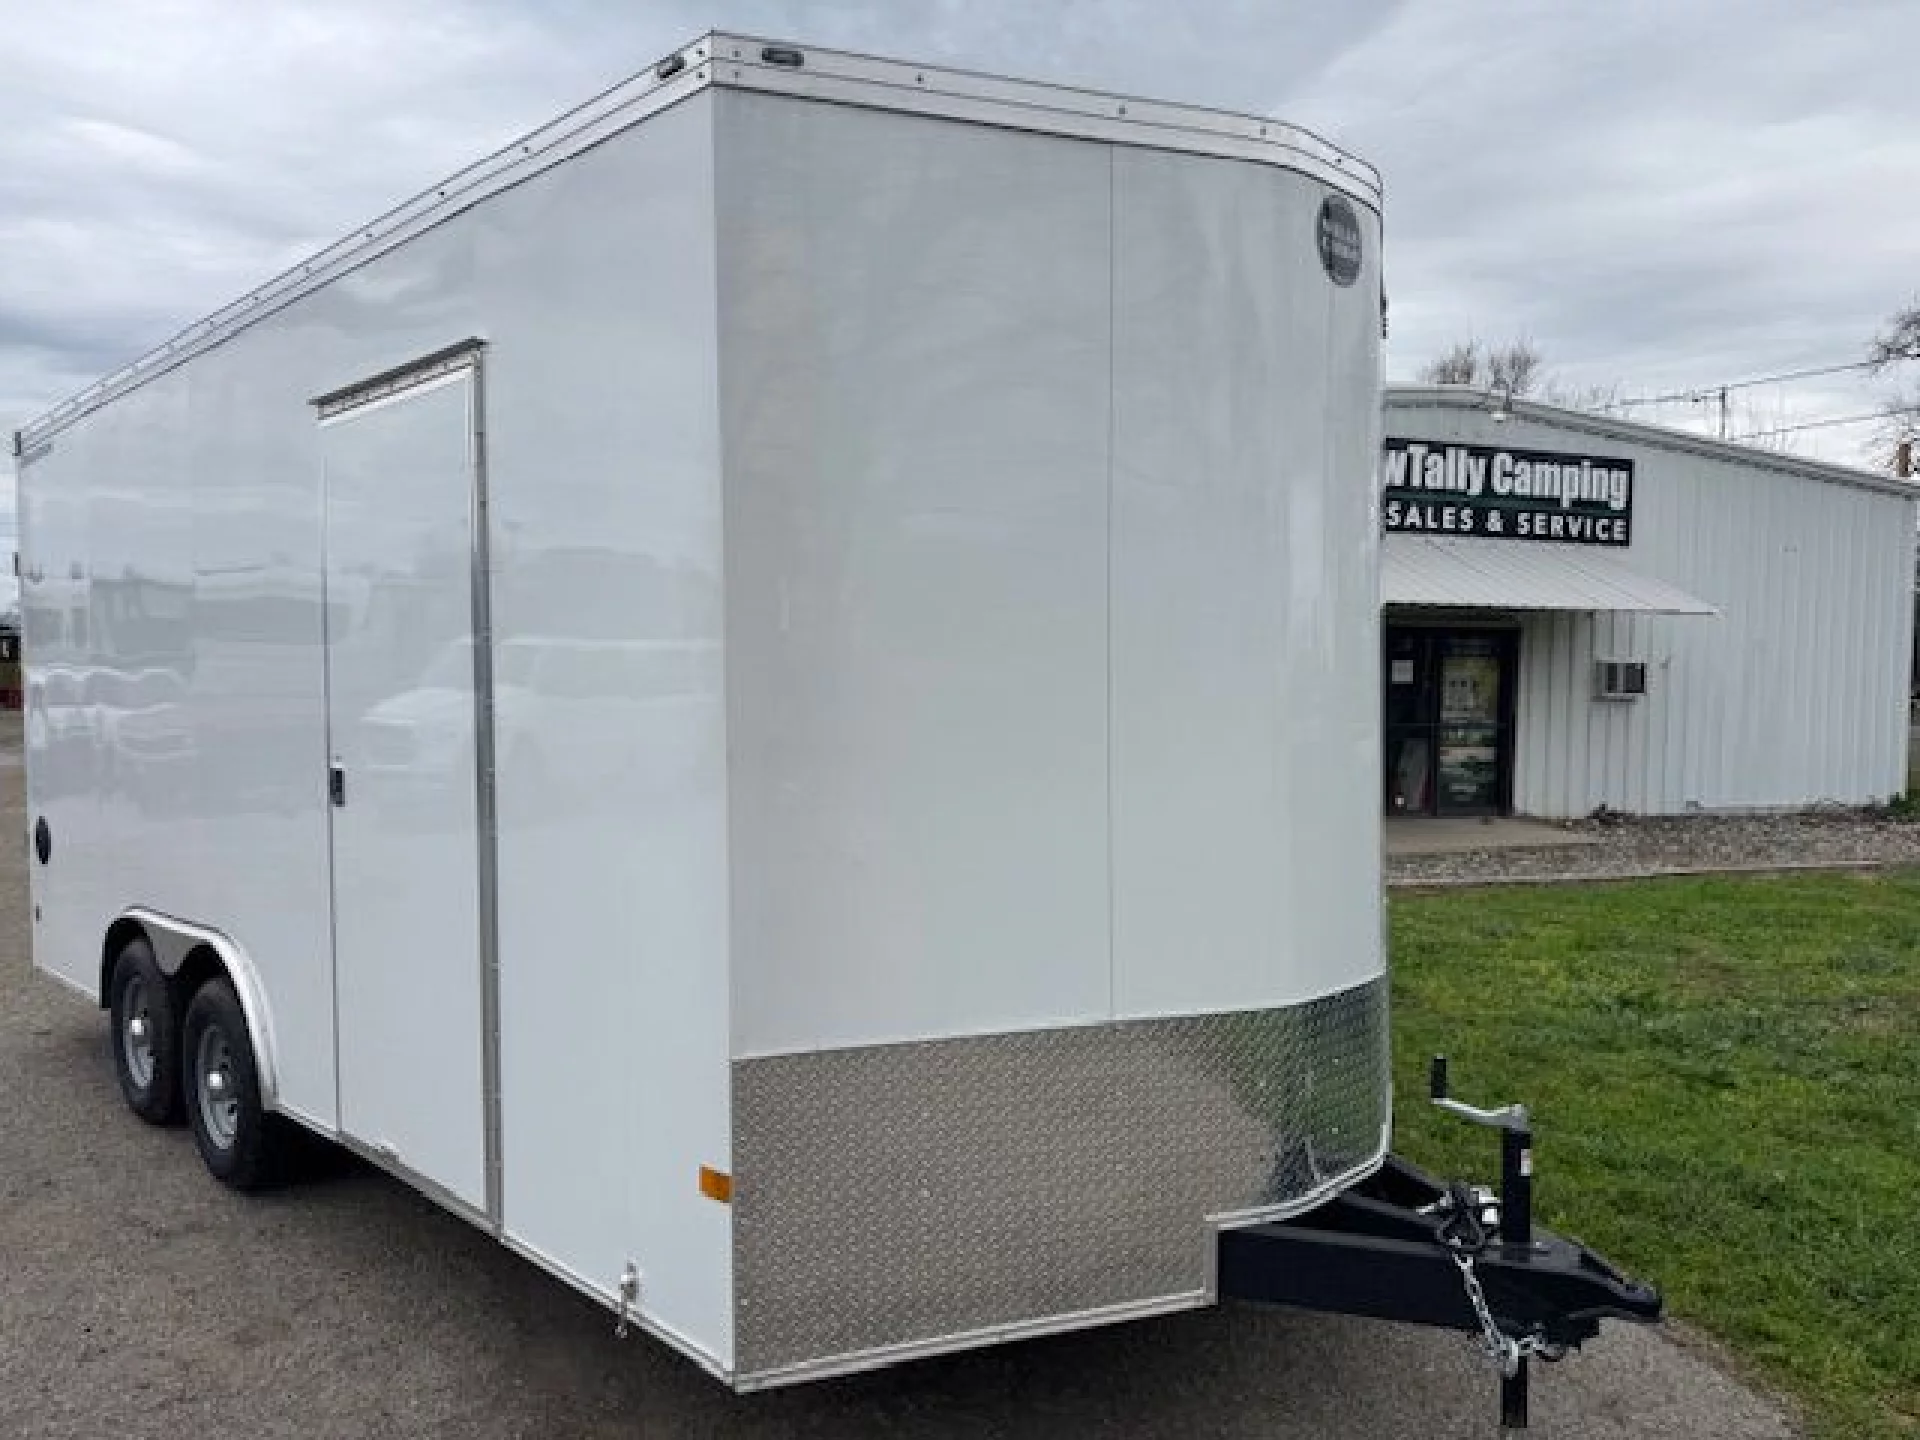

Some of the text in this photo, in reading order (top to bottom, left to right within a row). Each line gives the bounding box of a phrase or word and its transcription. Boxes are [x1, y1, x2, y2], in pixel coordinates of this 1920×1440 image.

[1493, 452, 1627, 510] Camping
[1387, 501, 1627, 542] SALES & SERVICE
